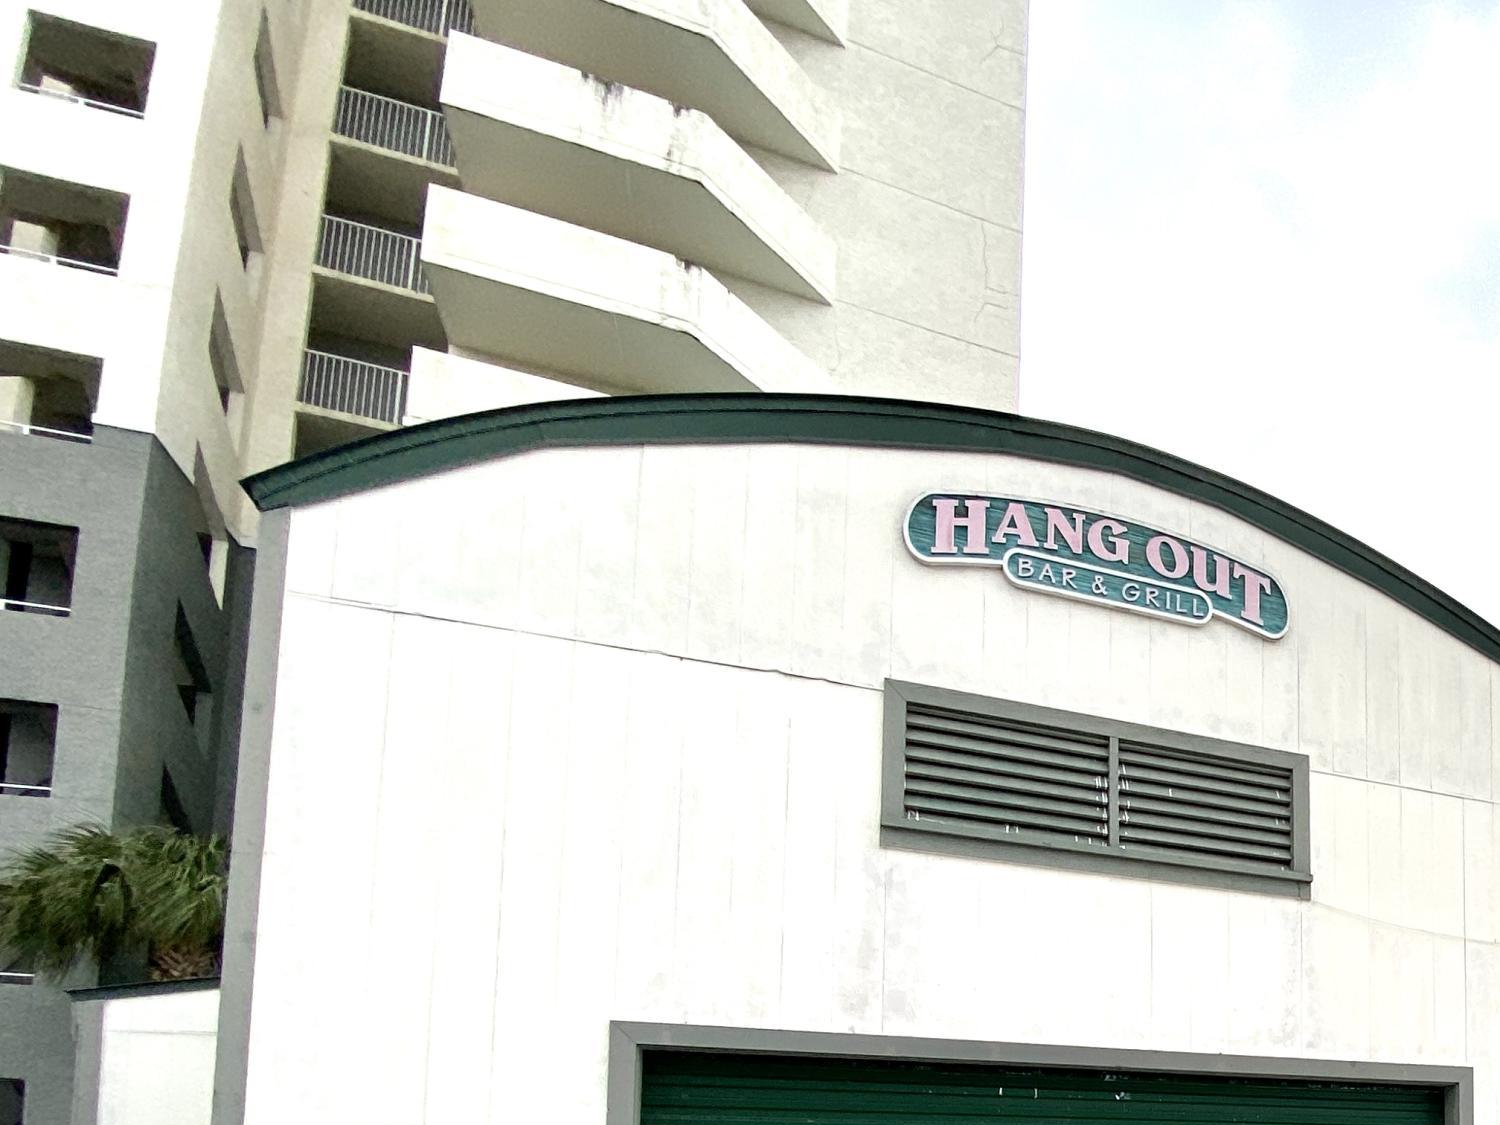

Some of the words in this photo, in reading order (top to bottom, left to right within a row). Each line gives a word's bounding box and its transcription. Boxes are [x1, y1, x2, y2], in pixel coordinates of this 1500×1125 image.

[930, 498, 1129, 564] HANG
[1145, 535, 1272, 626] OUT
[1017, 558, 1077, 589] BAR
[1091, 574, 1109, 595] &
[1121, 582, 1205, 617] GRILL
